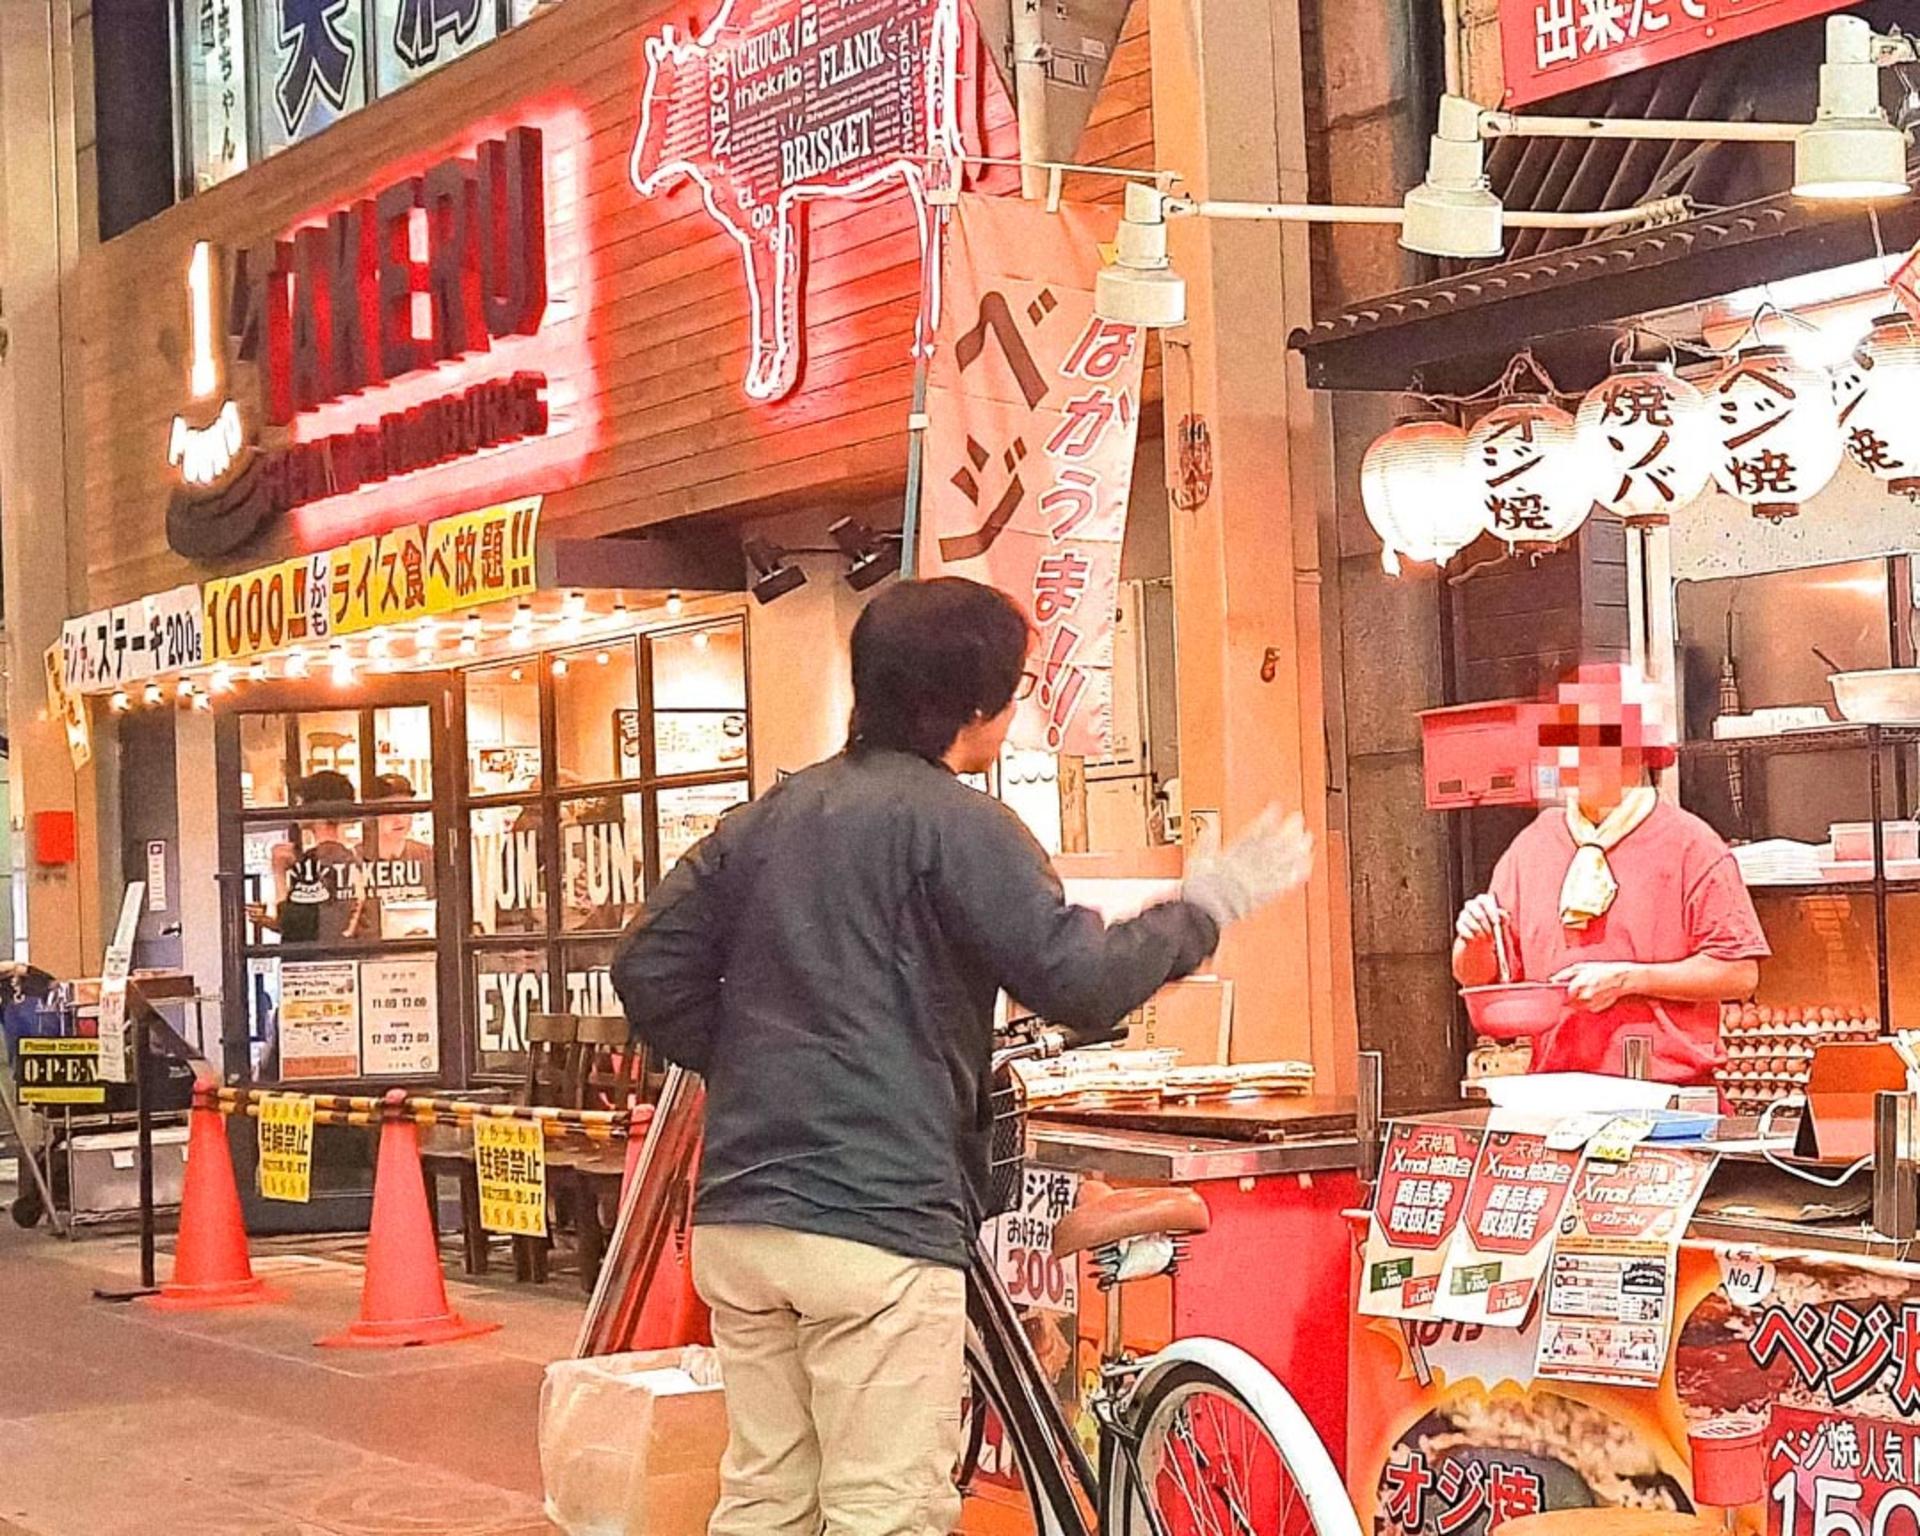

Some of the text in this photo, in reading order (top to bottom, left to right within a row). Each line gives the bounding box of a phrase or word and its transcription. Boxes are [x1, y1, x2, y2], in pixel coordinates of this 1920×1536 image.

[818, 25, 885, 89] FLANK
[1535, 0, 1708, 70] 出来た
[780, 107, 873, 188] BRISKET
[1600, 383, 1676, 502] 焼ソバ
[310, 555, 328, 636] しかも
[333, 860, 421, 888] TAKERU
[1007, 1248, 1064, 1303] 300
[1750, 1303, 1920, 1414] ベジ
